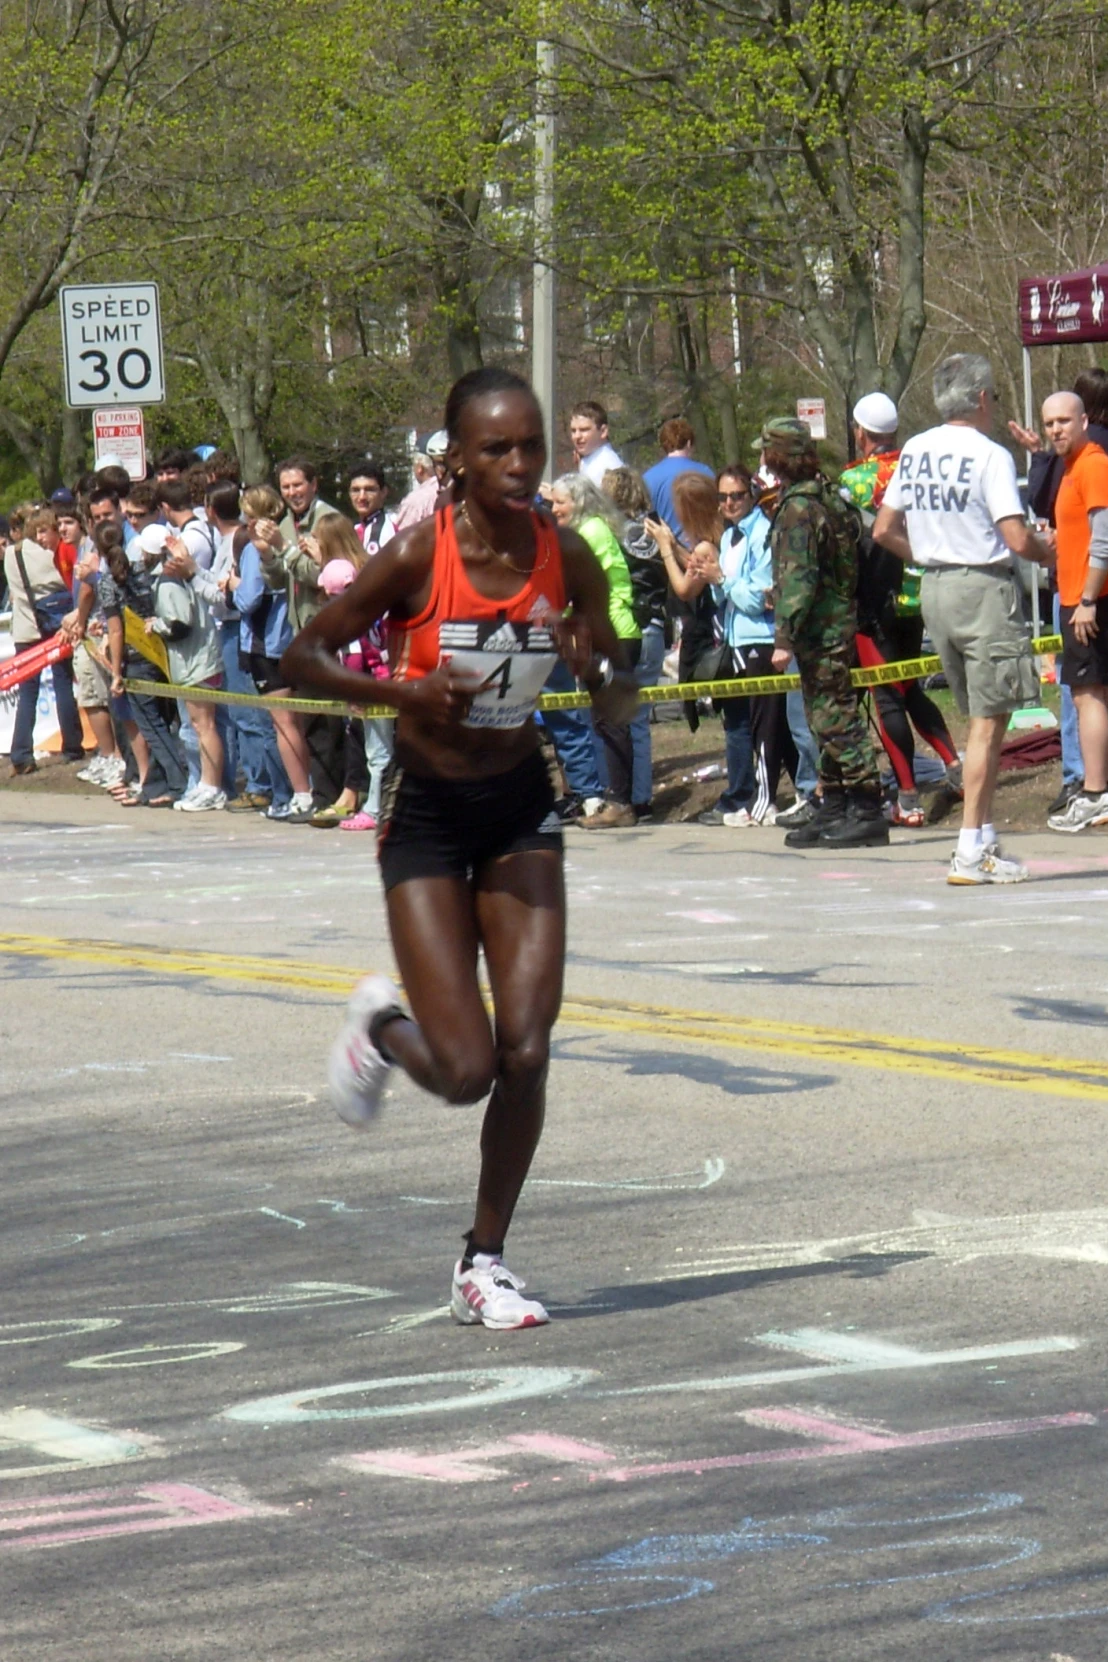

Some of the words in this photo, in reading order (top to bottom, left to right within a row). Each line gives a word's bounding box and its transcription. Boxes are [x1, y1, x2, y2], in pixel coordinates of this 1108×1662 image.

[72, 299, 151, 319] SPEED
[81, 323, 142, 343] LIMIT
[78, 347, 152, 392] 30
[98, 427, 115, 437] TOW
[118, 425, 140, 436] ZONE
[899, 451, 975, 484] RACE
[901, 483, 971, 513] CREW
[480, 656, 513, 700] 4
